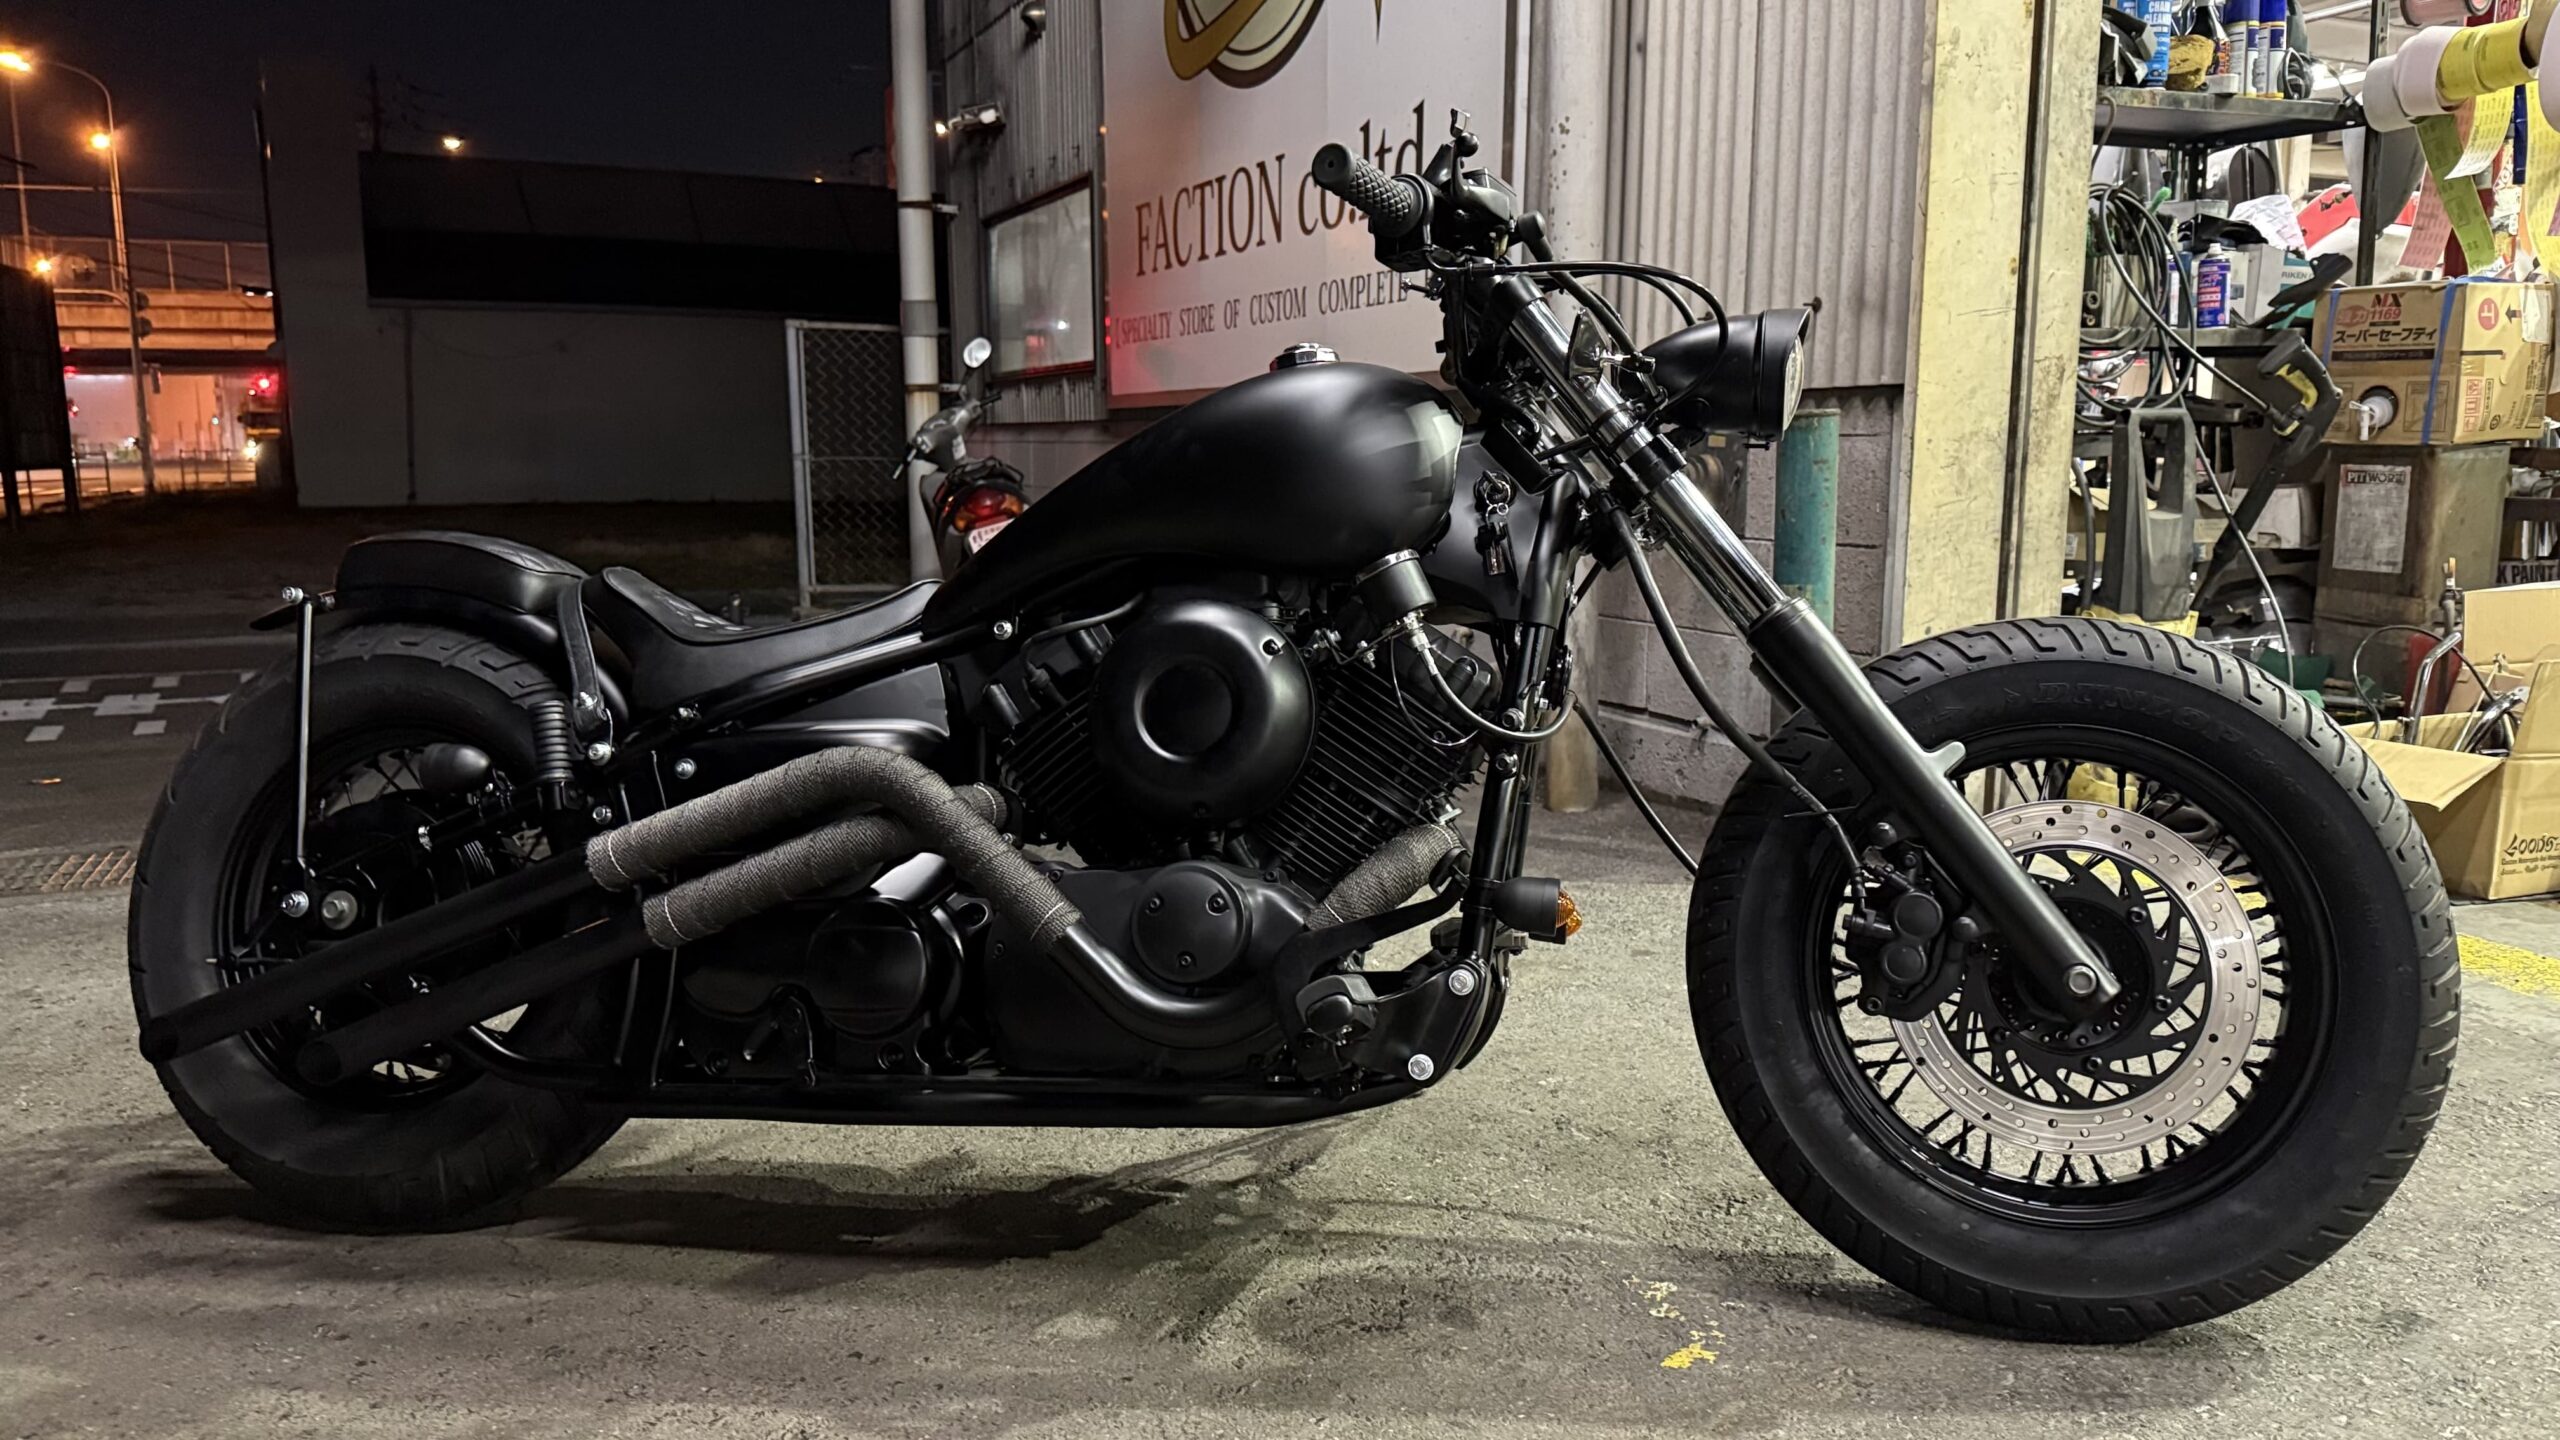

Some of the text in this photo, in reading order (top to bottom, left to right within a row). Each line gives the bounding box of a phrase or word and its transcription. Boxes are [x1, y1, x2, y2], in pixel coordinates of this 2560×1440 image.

[1136, 153, 1286, 277] FACTION
[1179, 303, 1215, 337] STORE
[1223, 298, 1240, 330] OF
[1250, 286, 1307, 326] CUSTOM
[2370, 308, 2401, 321] 1169
[2333, 327, 2438, 344] スーパーセーフティ
[2511, 563, 2556, 584] PAINT
[2032, 682, 2241, 743] DUNLOP
